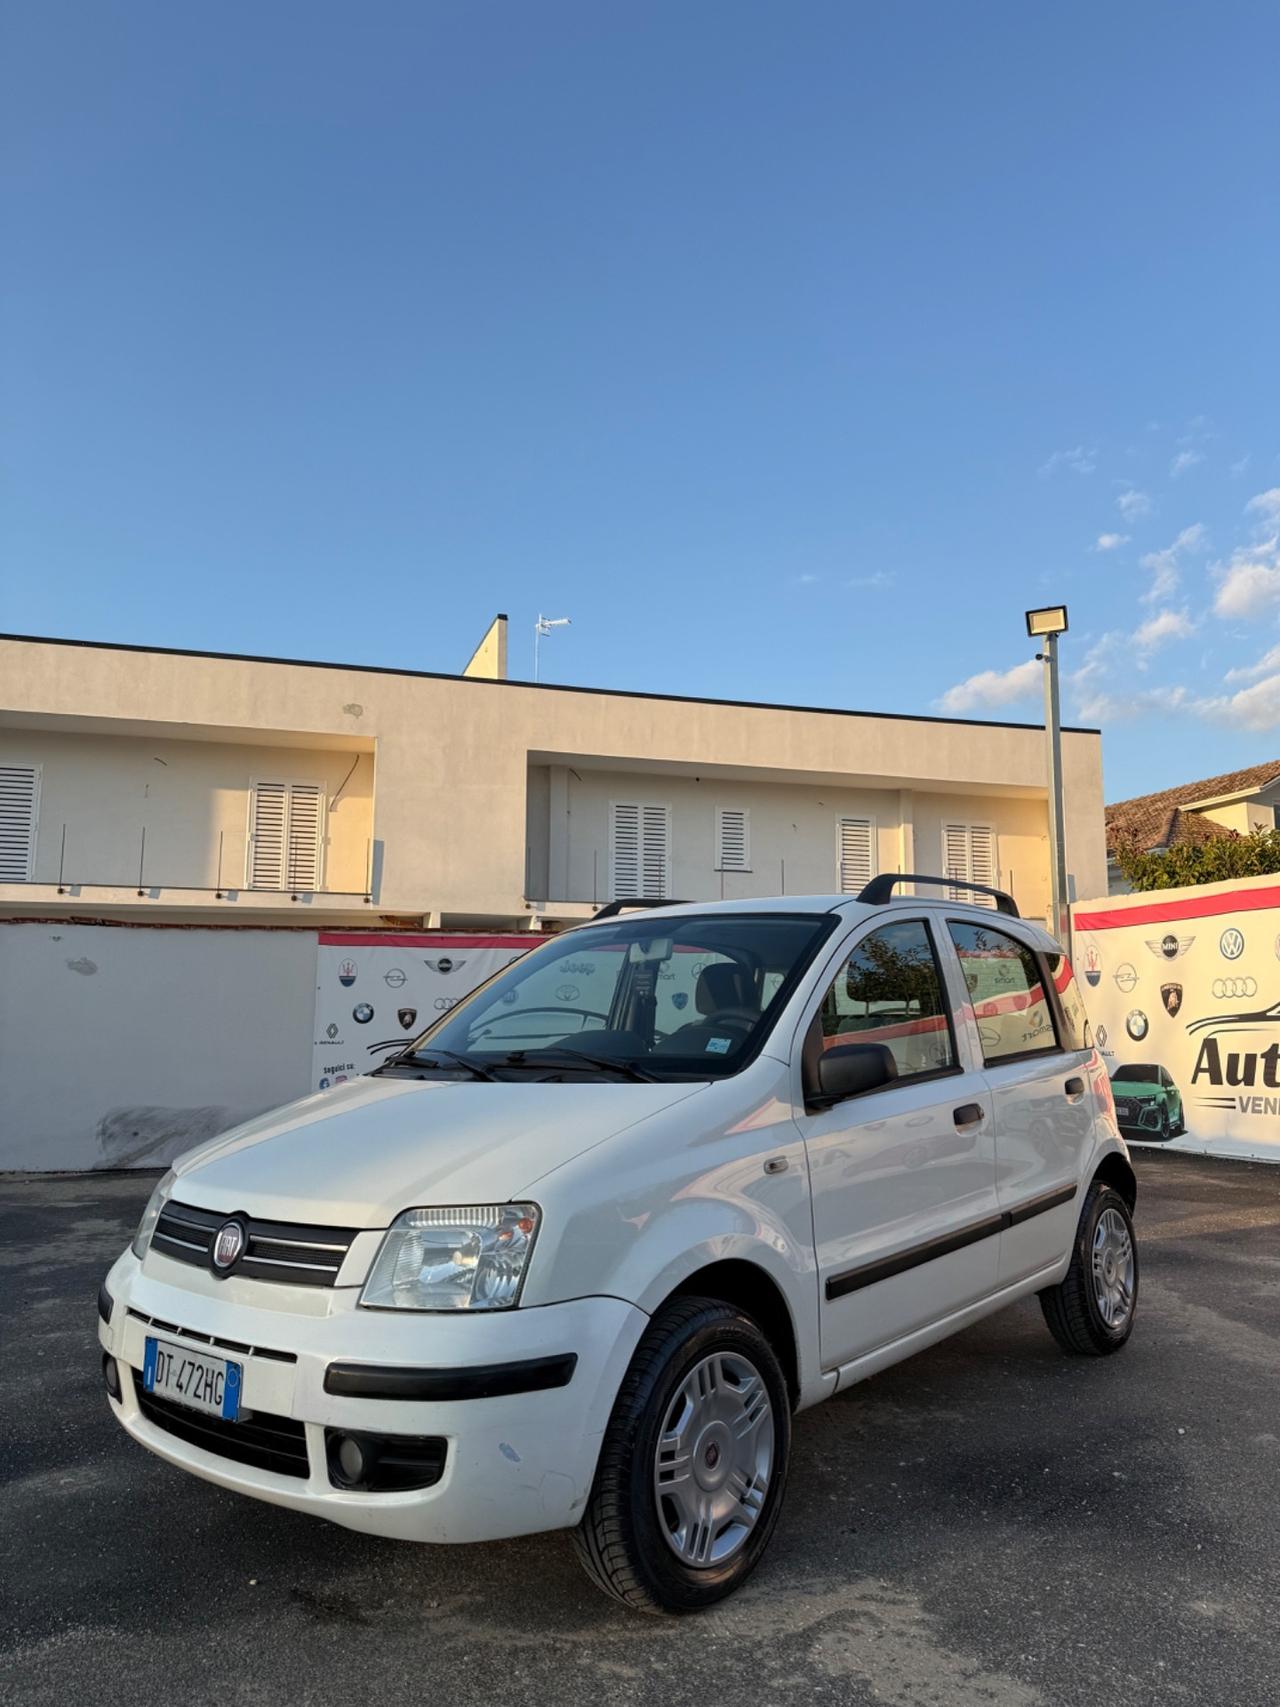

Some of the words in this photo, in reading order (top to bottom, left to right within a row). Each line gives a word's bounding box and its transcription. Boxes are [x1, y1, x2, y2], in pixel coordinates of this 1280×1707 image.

[1239, 1096, 1280, 1116] VEN
[218, 1235, 238, 1257] FIAT
[155, 1351, 173, 1387] DT
[176, 1359, 225, 1406] 472HG
